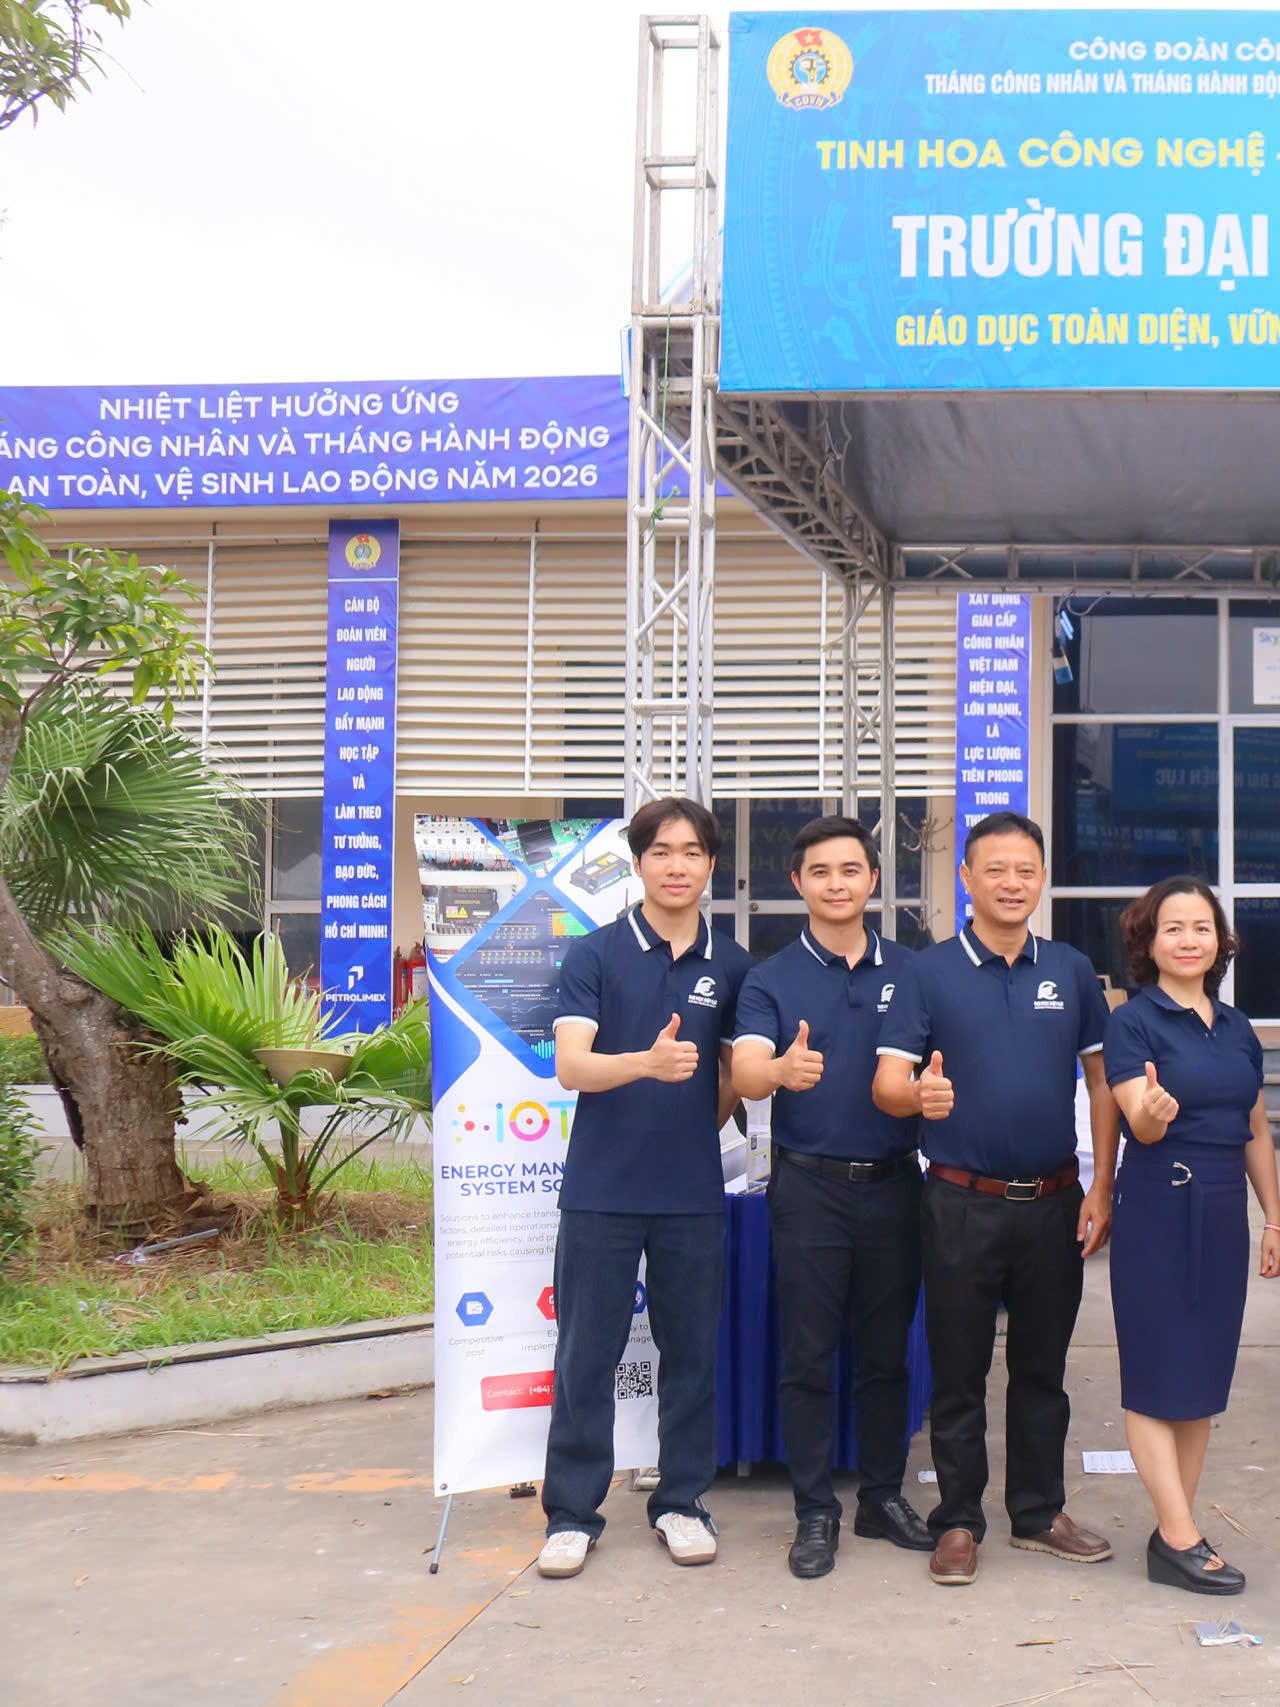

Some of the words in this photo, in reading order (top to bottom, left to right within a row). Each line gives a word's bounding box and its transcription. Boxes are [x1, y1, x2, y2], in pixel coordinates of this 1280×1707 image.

[1069, 36, 1147, 61] CÔNG
[1154, 36, 1228, 61] ĐOÀN
[925, 70, 986, 94] THÁNG
[991, 70, 1041, 94] CÔNG
[1046, 69, 1099, 94] NHÂN
[1103, 69, 1128, 93] VÀ
[1132, 69, 1192, 94] THÁNG
[1197, 70, 1248, 94] HÀNH
[816, 140, 904, 170] TINH
[919, 139, 1007, 168] HOA
[1018, 130, 1144, 168] CÔNG
[1157, 130, 1265, 176] NGHỆ
[892, 198, 1143, 278] TRƯỜNG
[1163, 214, 1268, 291] ĐẠI
[896, 308, 967, 346] GIÁO
[977, 314, 1039, 352] DỤC
[1048, 307, 1129, 345] TOÀN
[1138, 307, 1219, 351] DIỆN,
[100, 391, 192, 420] NHIỆT
[200, 390, 263, 424] LIỆT
[271, 388, 383, 417] HƯỞNG
[392, 386, 459, 415] ỨNG
[66, 430, 152, 458] CÔNG
[161, 428, 249, 457] NHÂN
[257, 427, 296, 455] VÀ
[304, 425, 412, 454] THÁNG
[421, 422, 510, 452] HÀNH
[518, 420, 610, 455] ĐỘNG
[7, 476, 49, 497] AN
[57, 467, 147, 499] TOÀN,
[155, 466, 193, 501] VỆ
[201, 472, 274, 495] SINH
[283, 471, 341, 493] LAO
[349, 462, 439, 497] ĐỘNG
[448, 460, 516, 489] NĂM
[524, 464, 597, 488] 2026
[345, 597, 364, 612] CÁN
[366, 596, 380, 615] BỘ
[971, 614, 993, 627] GIAI
[995, 610, 1017, 627] CẤP
[336, 626, 363, 642] ĐOÀN
[365, 626, 387, 642] VIÊN
[963, 634, 992, 649] CÔNG
[994, 634, 1024, 650] NHÂN
[346, 655, 376, 671] NGƯỜI
[969, 656, 991, 674] VIỆT
[993, 658, 1018, 672] NAM
[337, 687, 355, 701] LAO
[357, 685, 383, 703] ĐỘNG
[969, 678, 994, 696] HIỆN
[996, 680, 1017, 696] ĐẠI,
[964, 701, 985, 716] LỚN
[987, 703, 1022, 718] MẠNH,
[356, 717, 384, 733] MẠNH
[986, 723, 1000, 738] LÀ
[339, 746, 359, 763] HỌC
[361, 744, 379, 762] TẬP
[964, 746, 984, 763] LỰC
[986, 746, 1021, 762] LƯỢNG
[352, 773, 365, 789] VÀ
[961, 767, 985, 783] TIÊN
[987, 769, 1023, 782] PHONG
[975, 792, 1009, 805] TRONG
[335, 803, 356, 819] LÀM
[357, 805, 381, 819] THEO
[333, 835, 347, 849] TƯ
[347, 831, 382, 850] TƯỞNG,
[335, 865, 355, 881] ĐẠO
[356, 863, 379, 880] ĐỨC,
[326, 895, 359, 909] PHONG
[361, 893, 387, 909] CÁCH
[325, 921, 338, 938] HỒ
[340, 922, 356, 938] CHÍ
[359, 925, 387, 938] MINH!
[325, 993, 386, 1003] PETROLIMEX
[496, 1100, 576, 1143] IOT
[441, 1163, 515, 1179] ENERGY
[460, 1180, 535, 1196] SYSTEM
